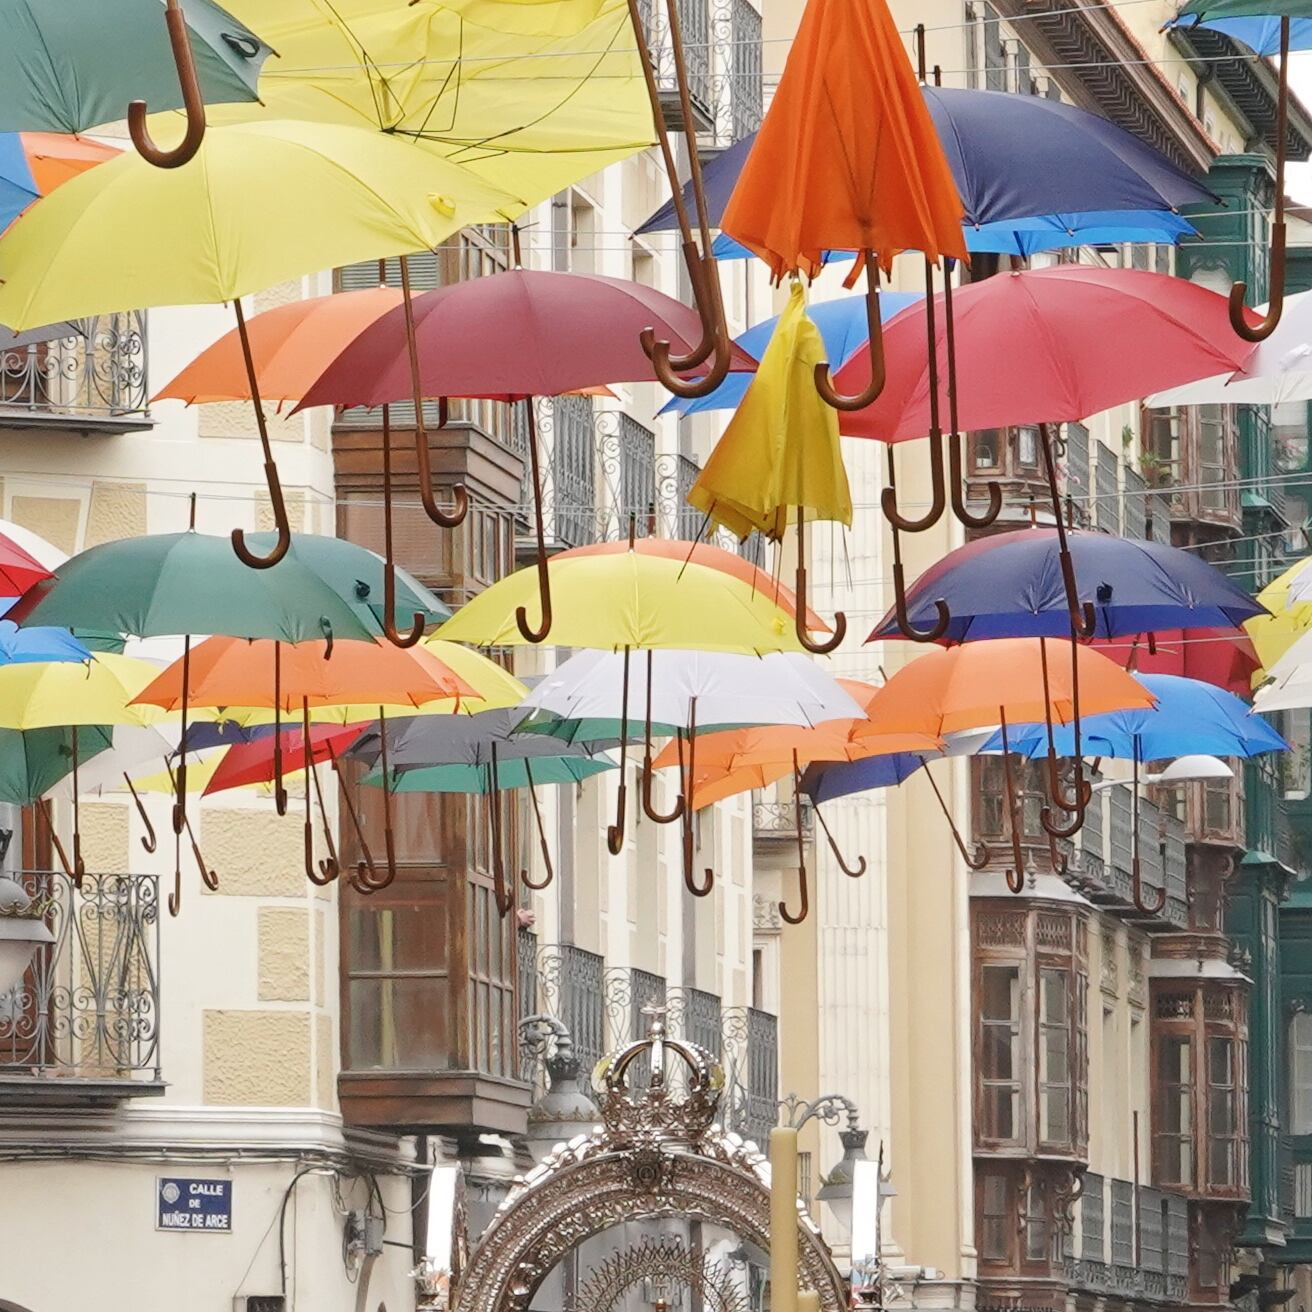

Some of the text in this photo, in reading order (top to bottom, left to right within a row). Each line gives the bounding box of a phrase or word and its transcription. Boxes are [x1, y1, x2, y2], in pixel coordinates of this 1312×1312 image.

[189, 1183, 223, 1196] CALLE
[189, 1199, 201, 1208] DE
[192, 1213, 204, 1227] DE
[205, 1214, 228, 1228] ARCE
